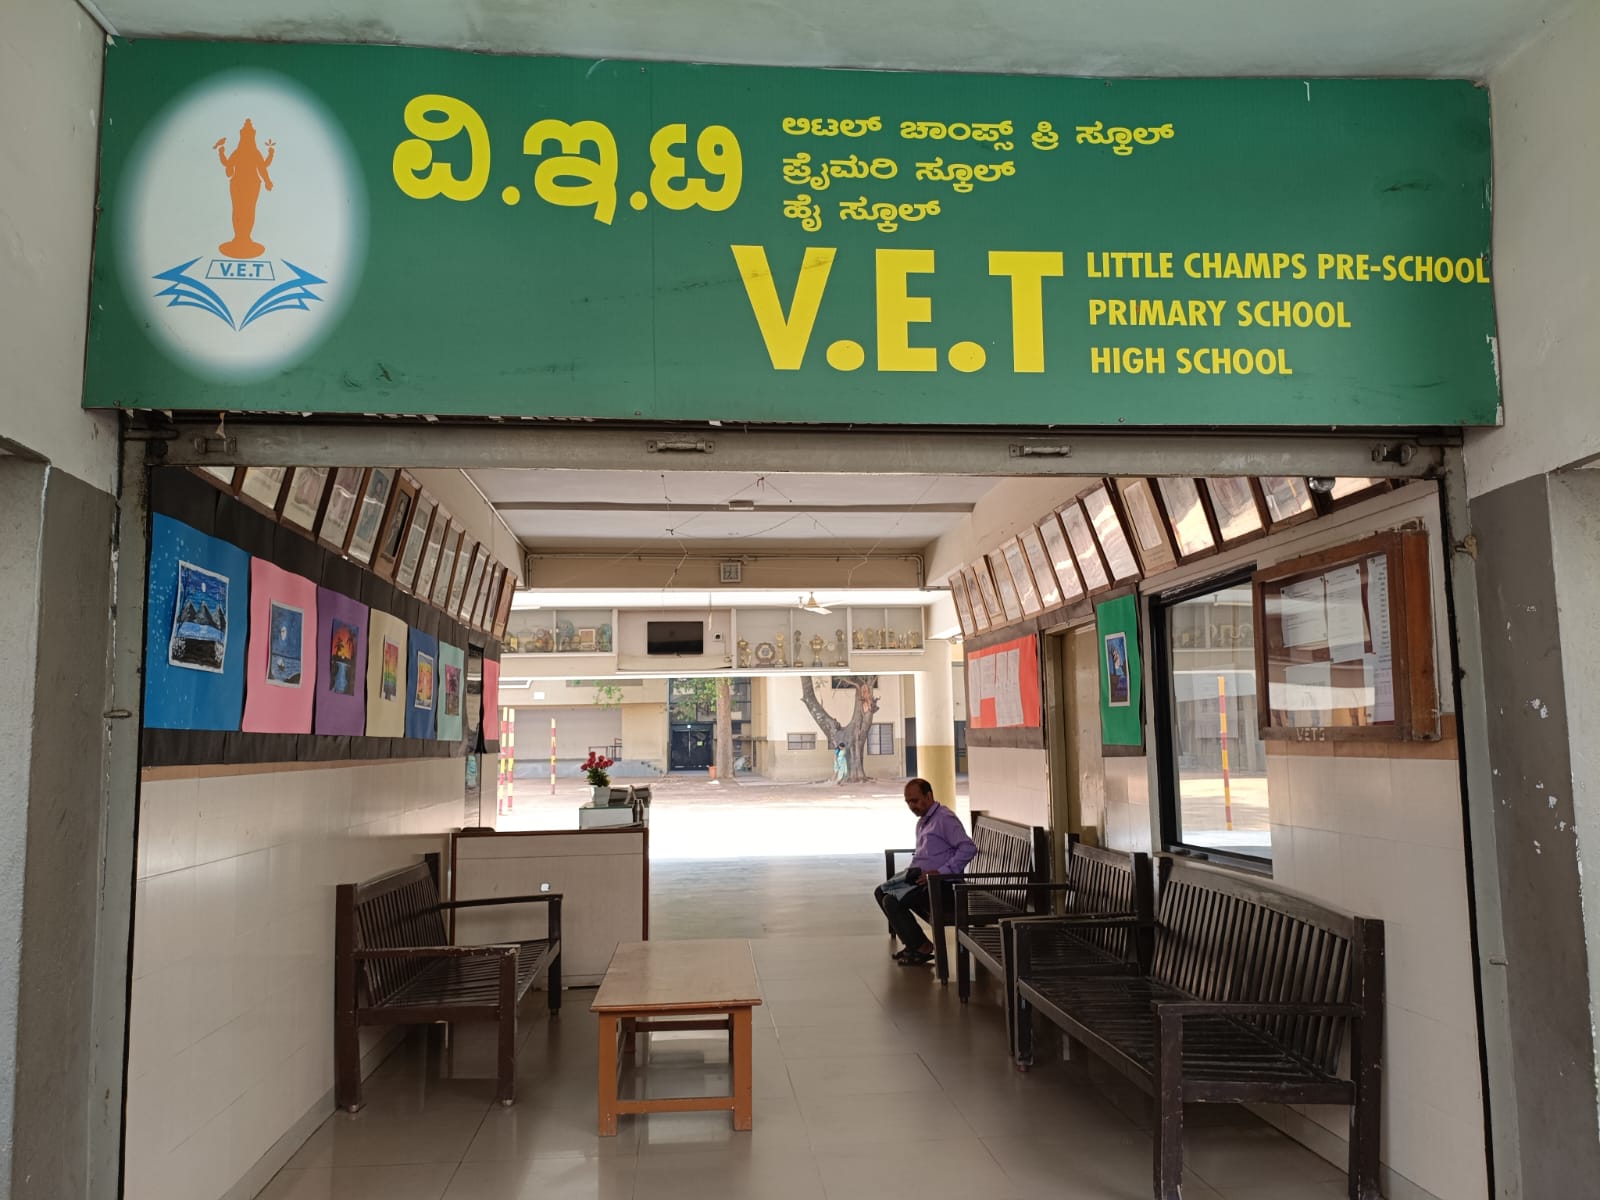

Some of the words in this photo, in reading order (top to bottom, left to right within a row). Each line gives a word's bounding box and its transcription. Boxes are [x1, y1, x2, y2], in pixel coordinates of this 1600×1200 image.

[1075, 119, 1175, 156] ಸ್ಕೂಲ್
[392, 94, 743, 225] ವಿ.ಇ.ಟಿ
[782, 152, 898, 191] ಪ್ರೈಮರಿ
[915, 156, 1017, 193] ಸ್ಕೂಲ್
[783, 193, 823, 232] ಹೈ
[839, 196, 942, 233] ಸ್ಕೂಲ್
[220, 262, 265, 278] V.E.T
[1087, 250, 1175, 280] LITTLE
[1184, 251, 1308, 281] CHAMPS
[1316, 253, 1491, 285] PRE-SCHOOL
[731, 244, 1064, 374] V.E.T
[1089, 299, 1226, 328] PRIMARY
[1236, 299, 1352, 329] SCHOOL
[1090, 346, 1166, 375] HIGH
[1176, 347, 1293, 376] SCHOOL
